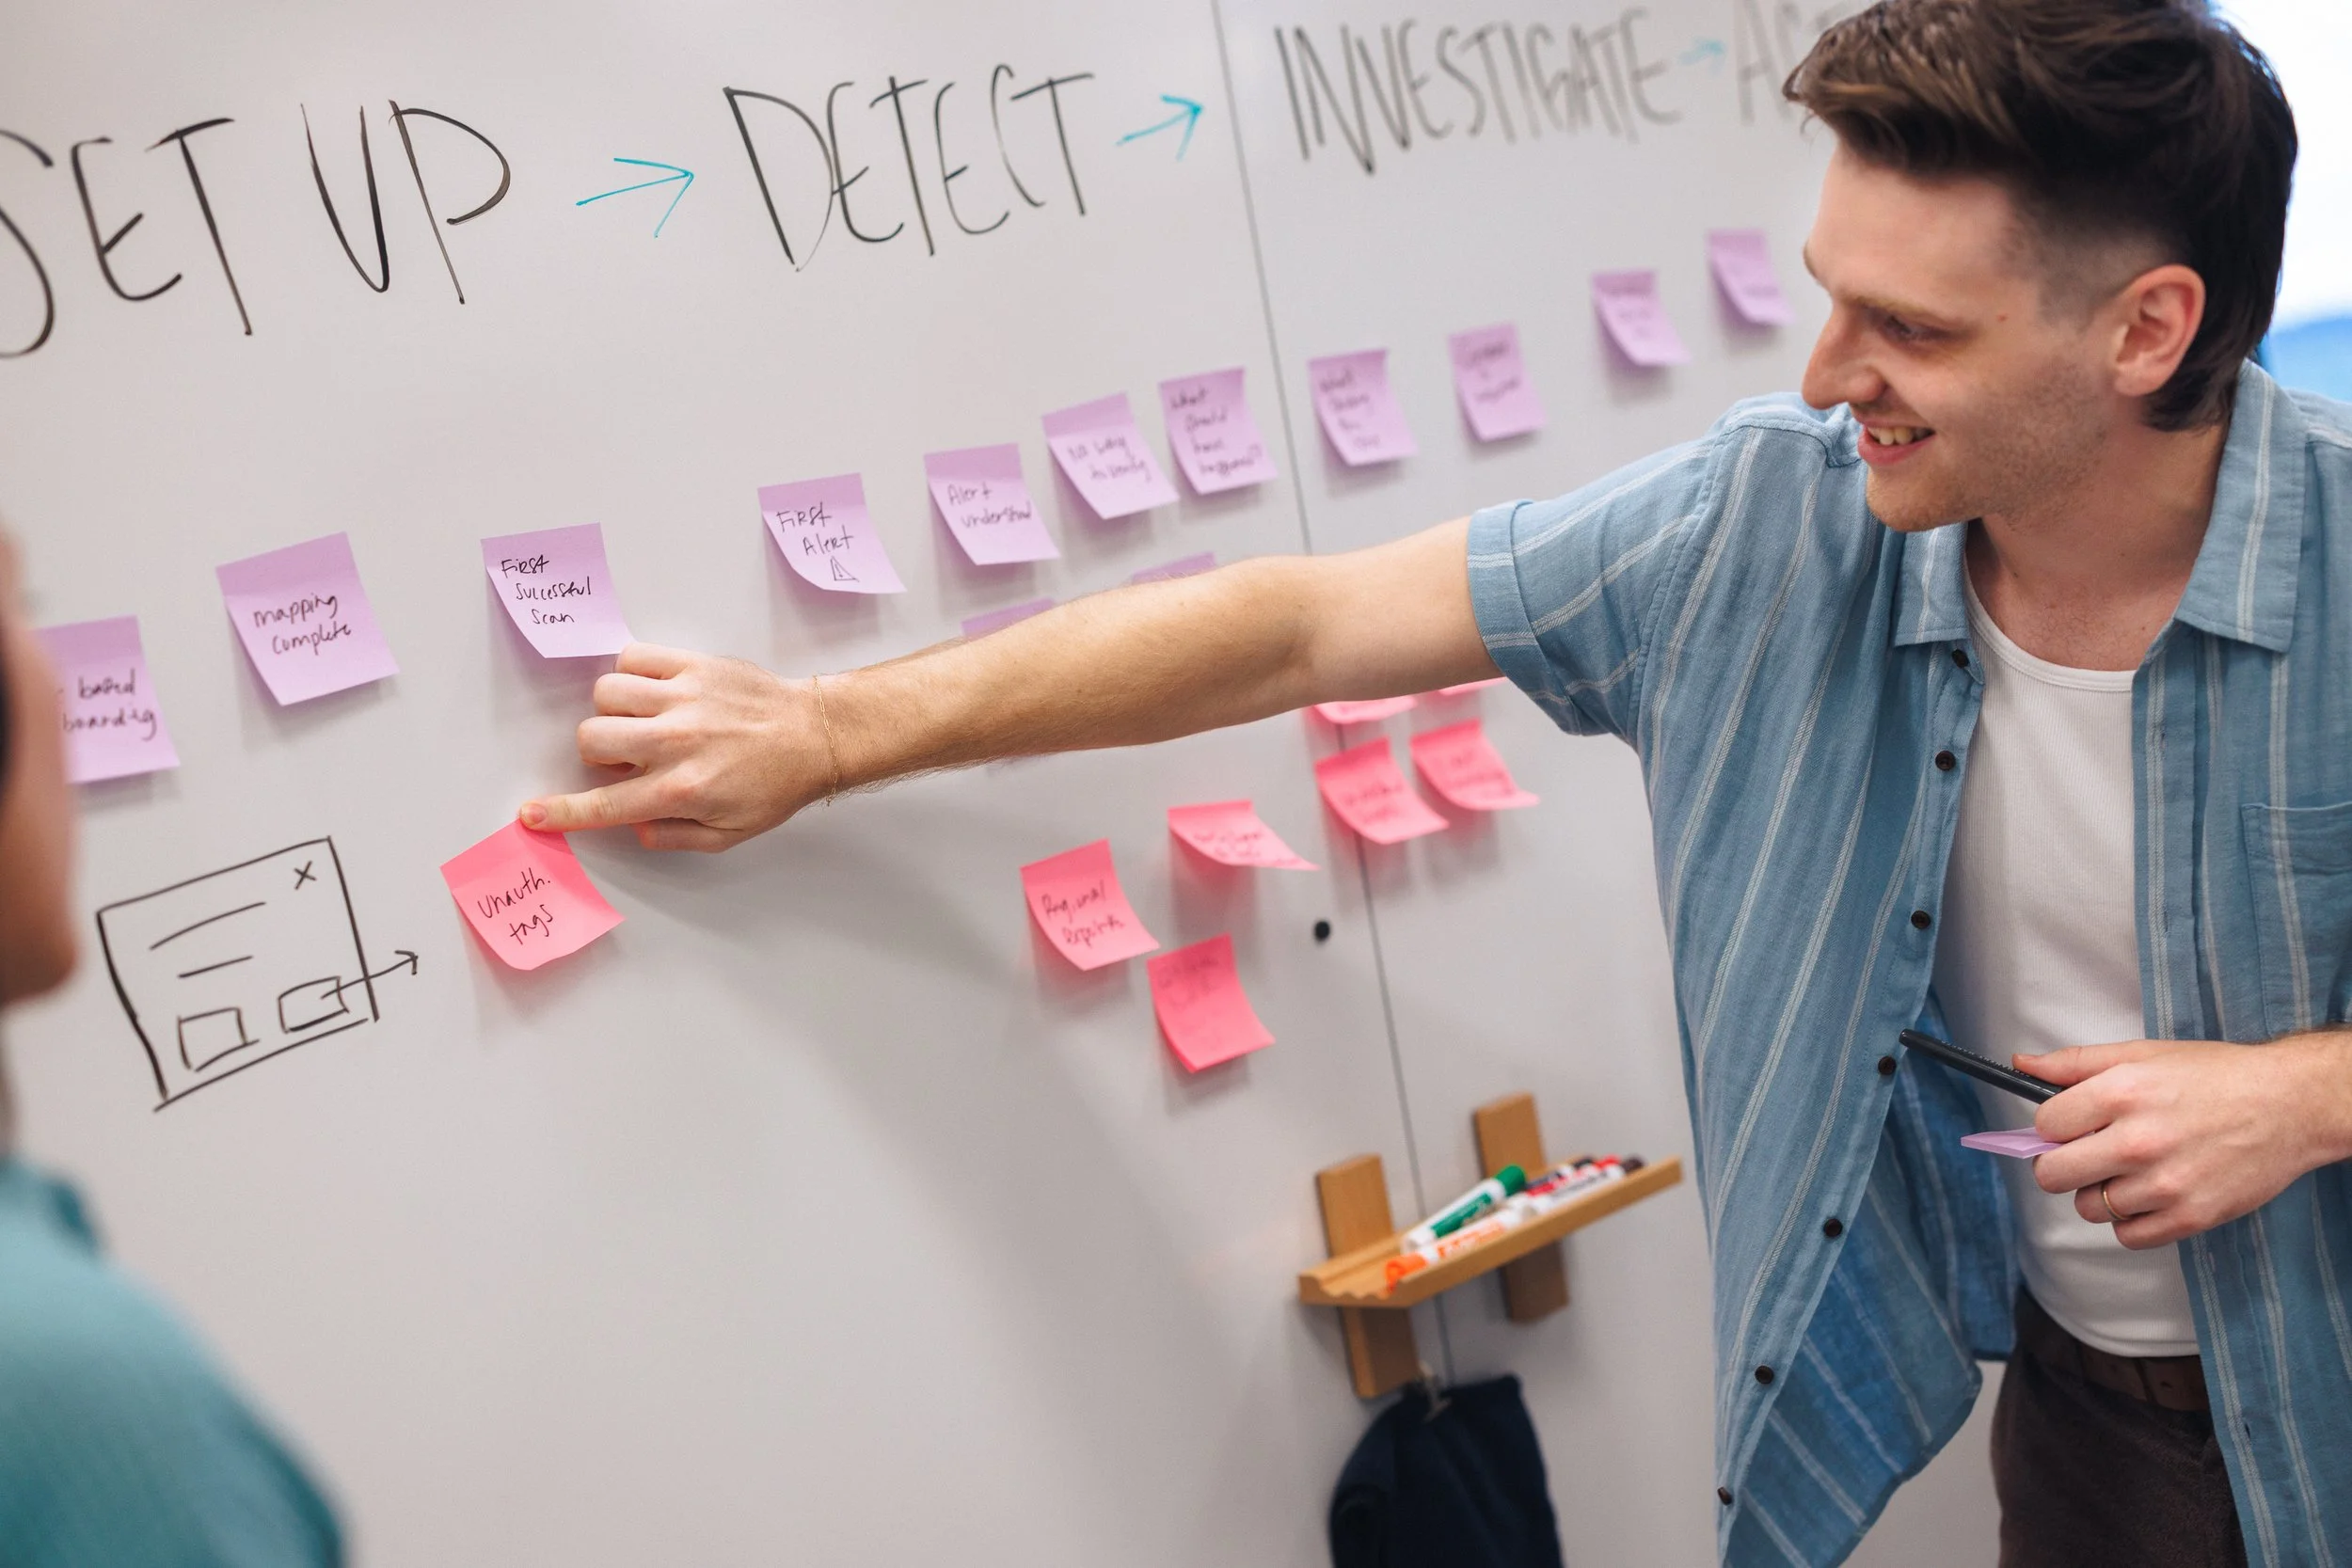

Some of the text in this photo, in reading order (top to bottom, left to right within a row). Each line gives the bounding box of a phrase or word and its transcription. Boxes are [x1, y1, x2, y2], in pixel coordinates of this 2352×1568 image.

[300, 99, 511, 304] UP
[722, 64, 1094, 273] DETECT
[1275, 8, 1684, 176] INVESTIGATE
[253, 592, 339, 628] mapping
